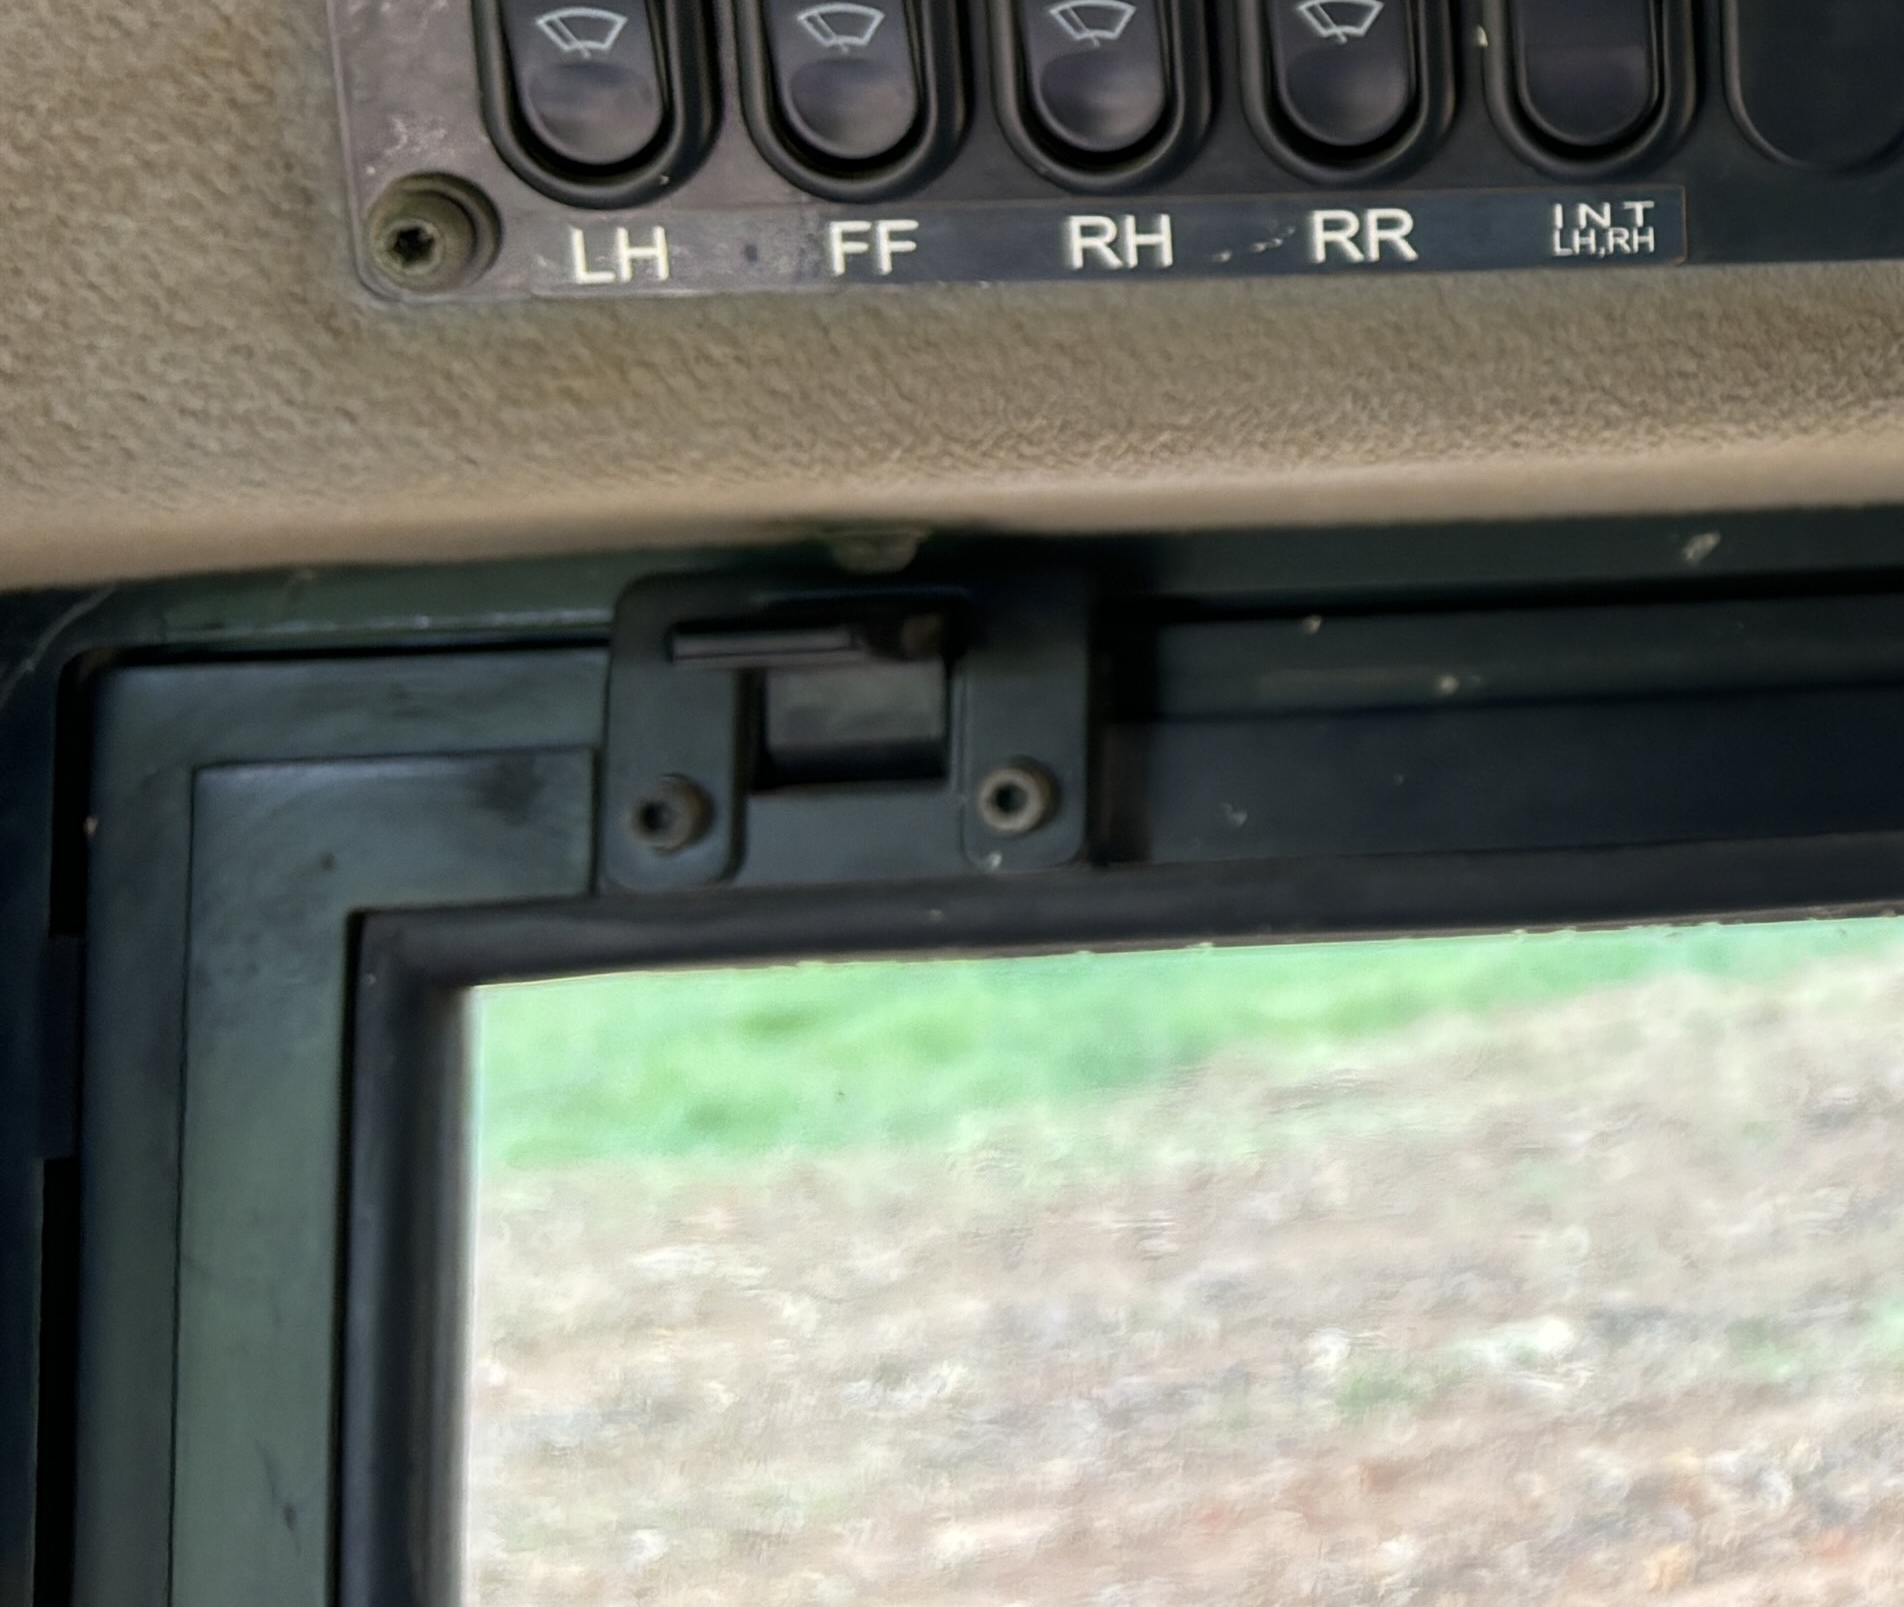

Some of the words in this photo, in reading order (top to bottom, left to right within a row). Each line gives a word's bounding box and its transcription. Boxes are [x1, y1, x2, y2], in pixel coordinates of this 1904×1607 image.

[569, 225, 671, 285] LH
[830, 219, 919, 276] FF
[1067, 214, 1174, 270] RH
[1309, 208, 1418, 263] RR
[1551, 225, 1656, 257] LH,RH
